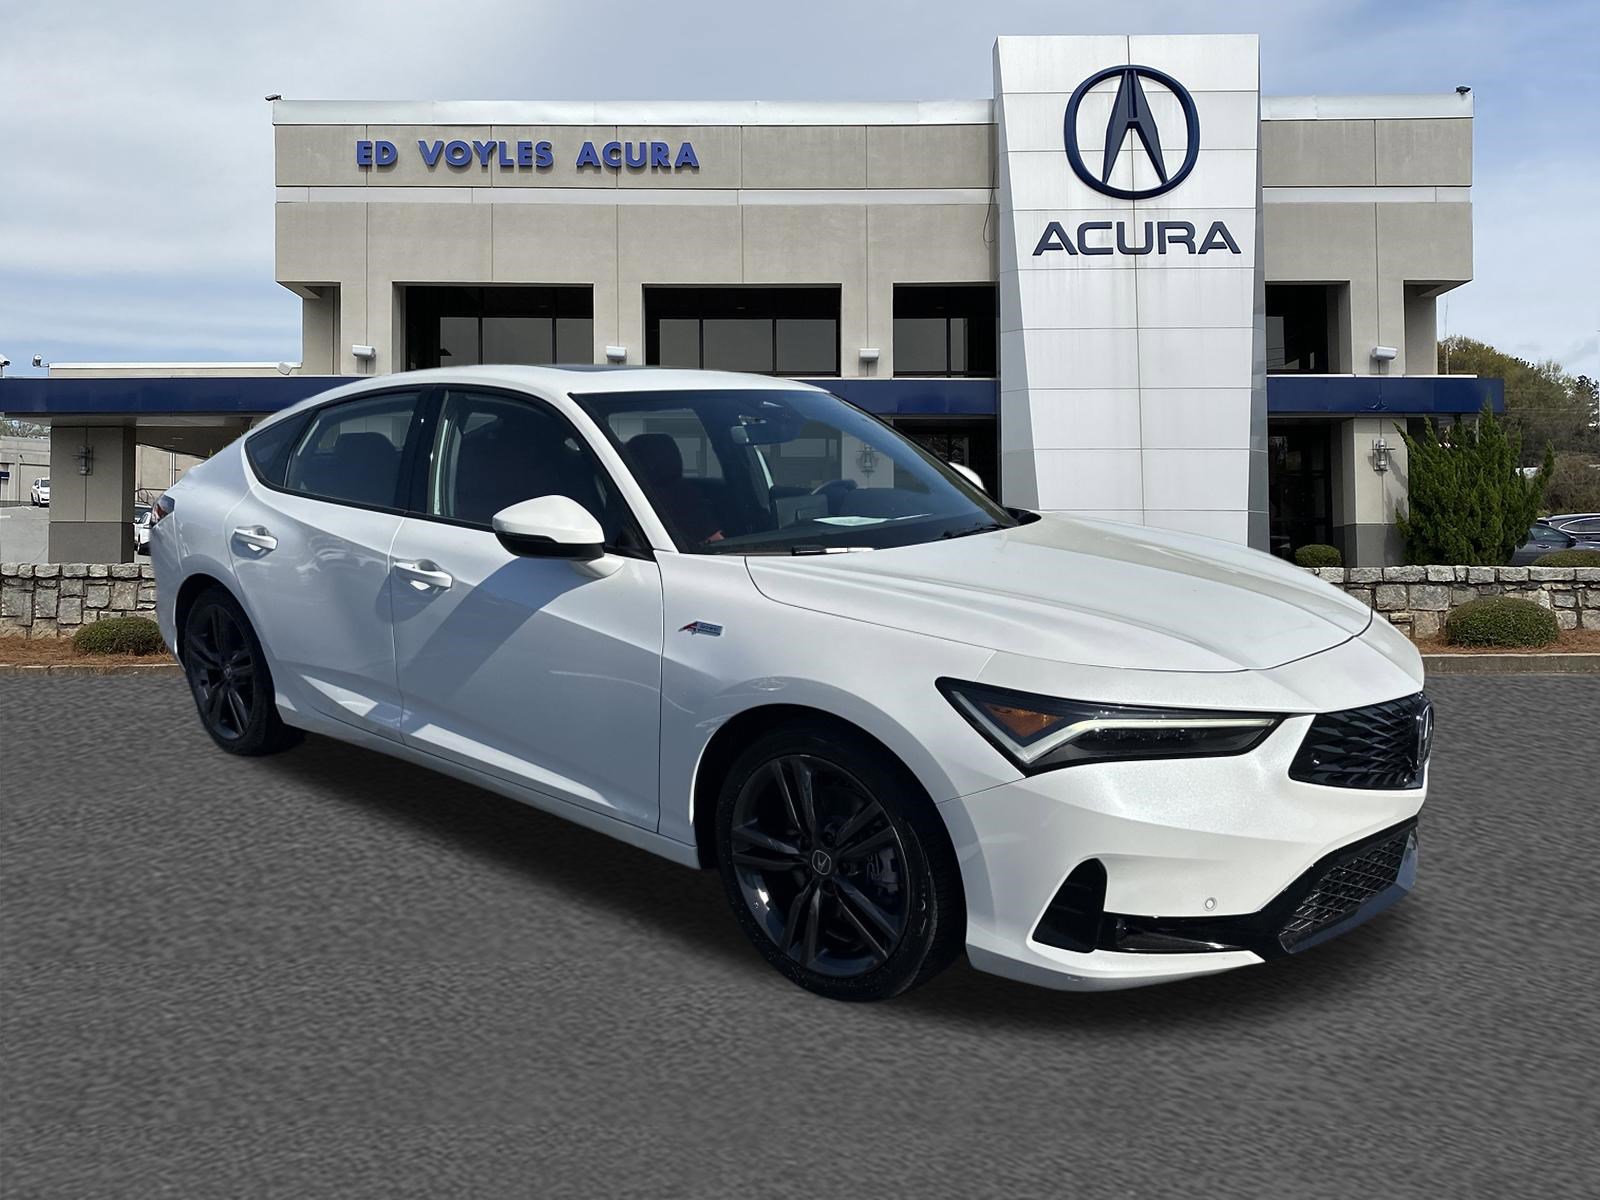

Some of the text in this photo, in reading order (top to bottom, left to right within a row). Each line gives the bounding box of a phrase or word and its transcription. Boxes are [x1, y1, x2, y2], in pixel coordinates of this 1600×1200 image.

[356, 140, 700, 169] ED VOYLES ACURA
[1032, 221, 1242, 256] ACURA
